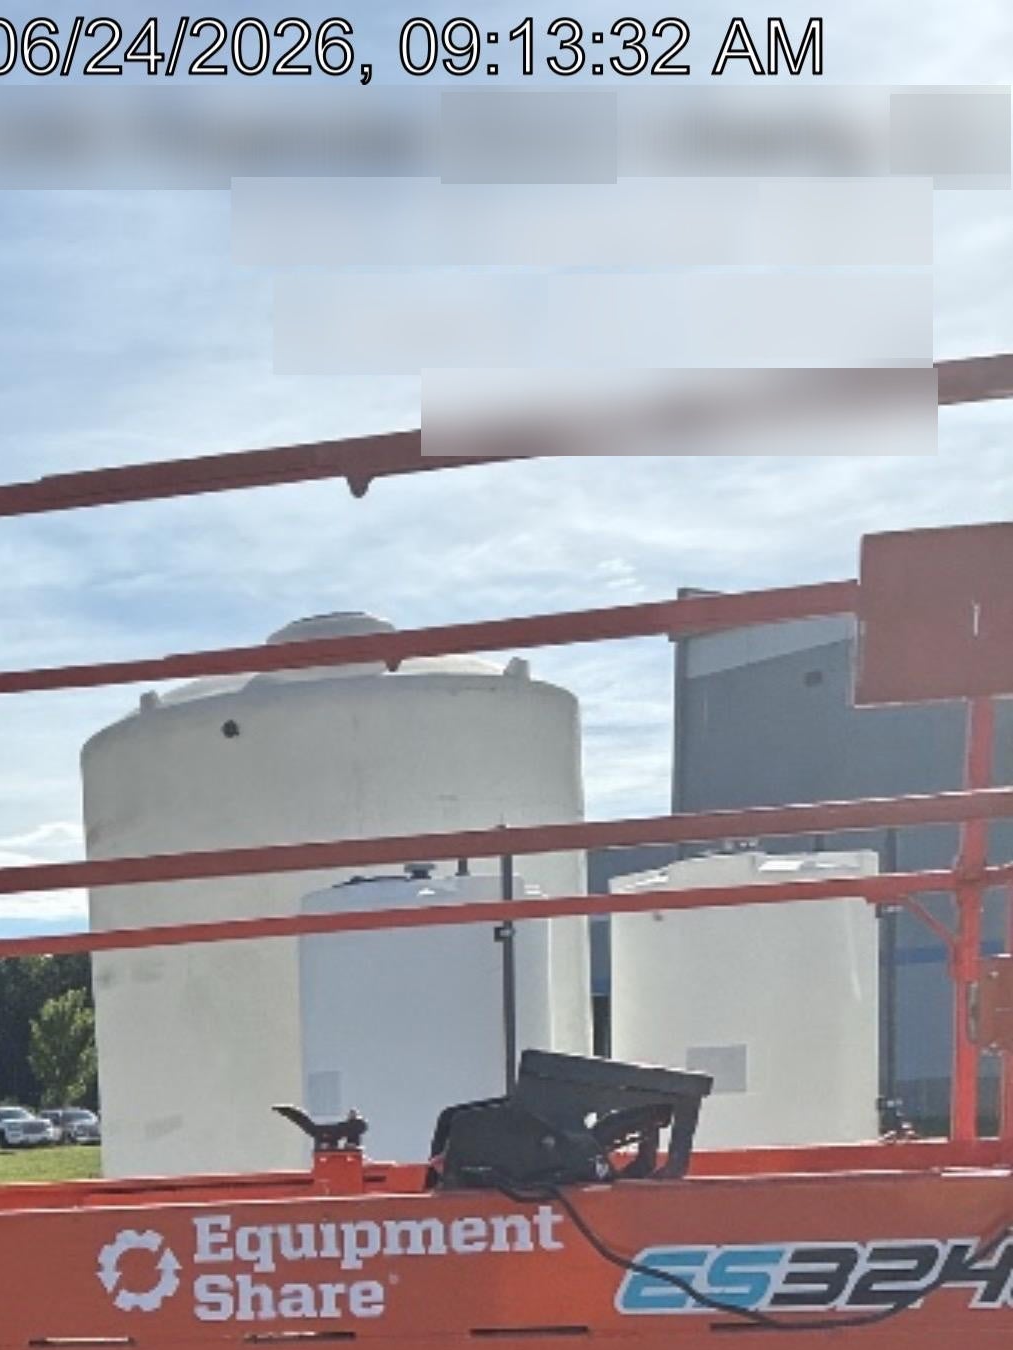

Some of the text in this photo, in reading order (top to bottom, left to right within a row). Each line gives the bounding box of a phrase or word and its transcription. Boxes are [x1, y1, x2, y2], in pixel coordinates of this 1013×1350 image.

[192, 1205, 566, 1272] Equipment
[193, 1273, 385, 1321] Share
[614, 1238, 1013, 1315] ES324
